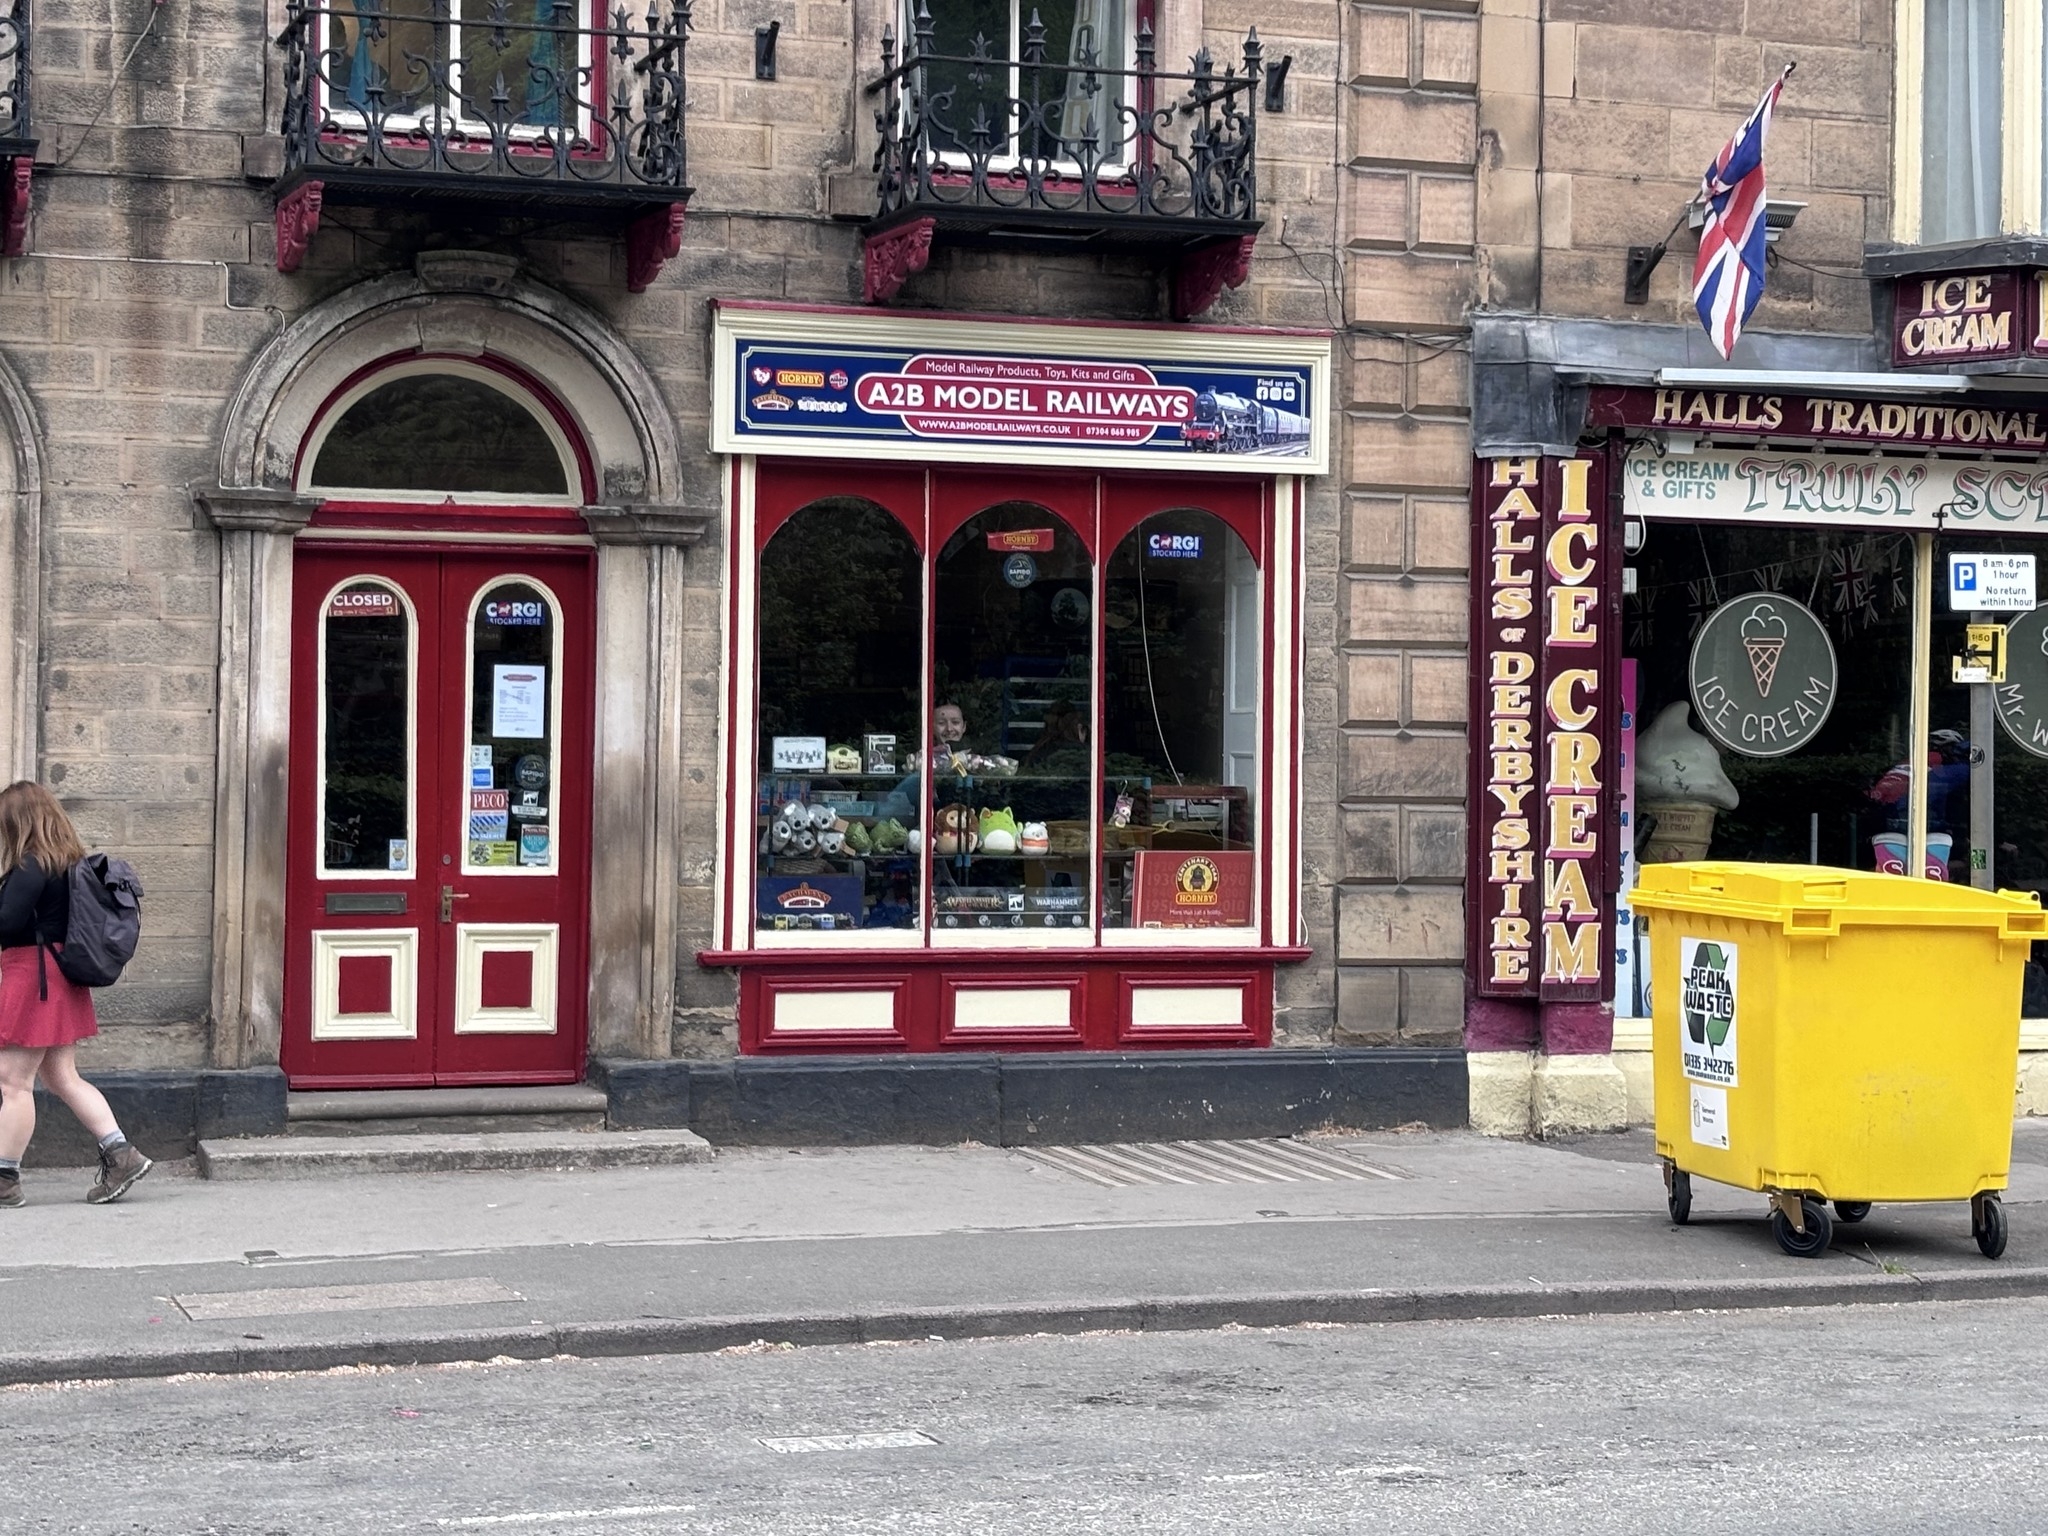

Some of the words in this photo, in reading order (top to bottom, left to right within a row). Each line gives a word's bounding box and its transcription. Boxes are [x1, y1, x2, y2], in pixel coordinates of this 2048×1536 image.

[1919, 275, 1992, 317] ICE
[1902, 311, 2012, 357] CREAM
[780, 373, 820, 384] HORNBY
[925, 360, 956, 373] Model
[959, 363, 994, 377] Railway
[998, 365, 1042, 379] Products,
[1071, 368, 1089, 379] Kits
[1093, 369, 1110, 380] and
[1112, 370, 1135, 381] Gifts
[1257, 379, 1273, 387] Find
[868, 382, 925, 407] A2B
[934, 385, 1038, 411] MODEL
[1046, 390, 1189, 418] RAILWAYS
[918, 419, 1071, 435] WWW.A2BMODELRAILWAYS.CO.UK
[1651, 389, 1784, 430] HALL'S
[1806, 397, 2047, 445] TRADITIONAL
[1627, 459, 1657, 478] ICE
[1661, 460, 1730, 481] CREAM
[1641, 480, 1656, 497] &
[1662, 481, 1717, 500] GIFTS
[1735, 457, 1928, 516] TRULY
[1490, 458, 1541, 619] HALLS
[1546, 460, 1598, 648] ICE
[1982, 559, 1988, 568] 8
[1990, 560, 2003, 568] am
[2016, 560, 2029, 570] pm
[1993, 570, 1997, 579] 1
[1999, 570, 2019, 579] hour
[333, 594, 393, 607] CLOSED
[1985, 586, 1999, 595] No
[2000, 586, 2027, 595] return
[1980, 597, 2006, 606] within
[2013, 597, 2033, 606] hour
[1500, 627, 1527, 643] OF
[1697, 676, 1739, 730] ICE
[1741, 676, 1831, 744] CREAM
[473, 793, 505, 808] PECO
[1487, 651, 1537, 984] DERBYSHIRE
[1541, 668, 1602, 984] CREAM
[1035, 898, 1079, 906] WARHAMMER
[1179, 894, 1214, 903] HORNBY
[1691, 967, 1726, 993] PEAK
[1685, 989, 1731, 1016] WASTE
[1684, 1053, 1701, 1071] 01335
[1703, 1056, 1735, 1076] 342276
[1701, 1106, 1716, 1115] General
